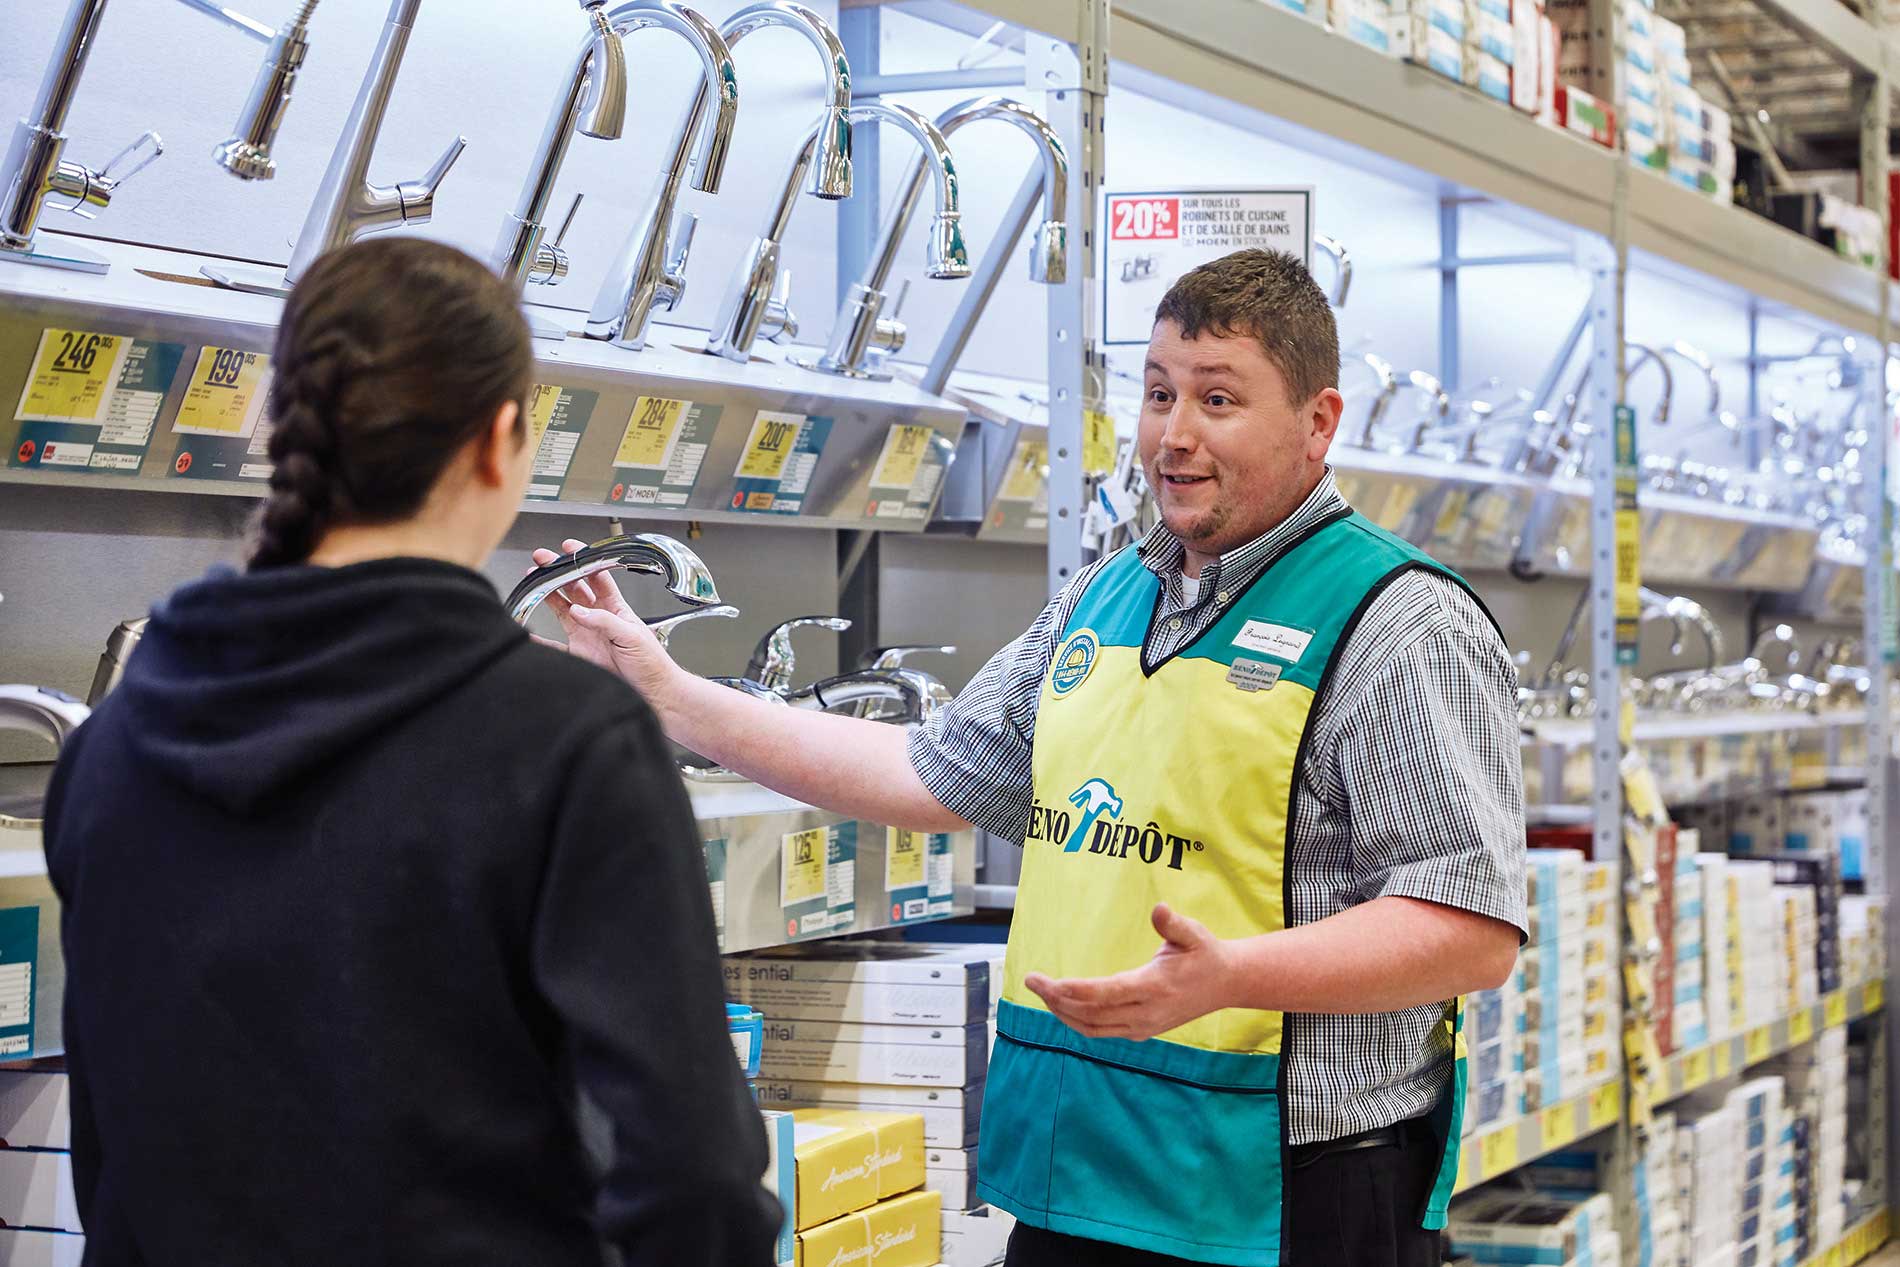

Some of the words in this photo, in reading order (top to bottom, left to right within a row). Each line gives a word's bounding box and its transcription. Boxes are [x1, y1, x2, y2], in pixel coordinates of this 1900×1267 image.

[1182, 199, 1199, 209] SUR
[1201, 199, 1223, 209] TOUS
[1225, 199, 1241, 209] LES
[1182, 211, 1230, 221] ROBINETS
[1233, 211, 1245, 221] DE
[1247, 210, 1287, 221] CUISINE
[1115, 201, 1171, 238] 20%
[1182, 225, 1194, 235] ET
[1196, 225, 1208, 235] DE
[1211, 224, 1242, 235] SALLE
[1244, 225, 1257, 235] DE
[1260, 224, 1290, 235] BAINS
[1197, 238, 1229, 246] MOEN
[53, 332, 100, 370] 246
[208, 349, 245, 383] 199
[638, 397, 670, 427] 284
[759, 421, 787, 449] 200
[636, 489, 656, 498] MOEN
[1027, 799, 1070, 845] ÉNO
